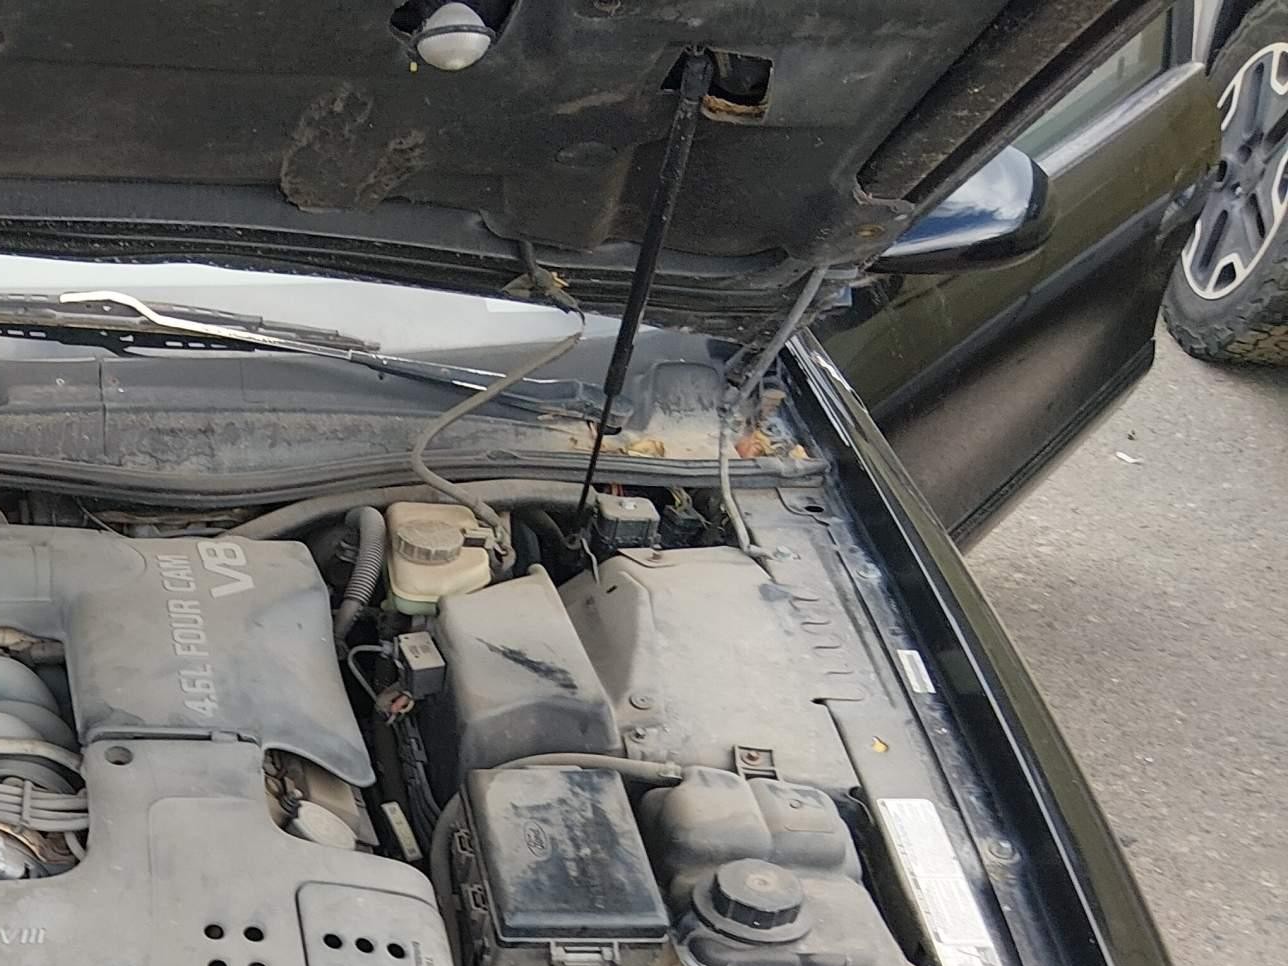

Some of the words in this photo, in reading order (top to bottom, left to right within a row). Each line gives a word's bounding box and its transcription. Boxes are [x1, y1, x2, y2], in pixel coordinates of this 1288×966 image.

[156, 554, 197, 592] CAM
[196, 540, 256, 600] V8
[167, 599, 210, 657] FOUR
[177, 663, 219, 718] 4.6L
